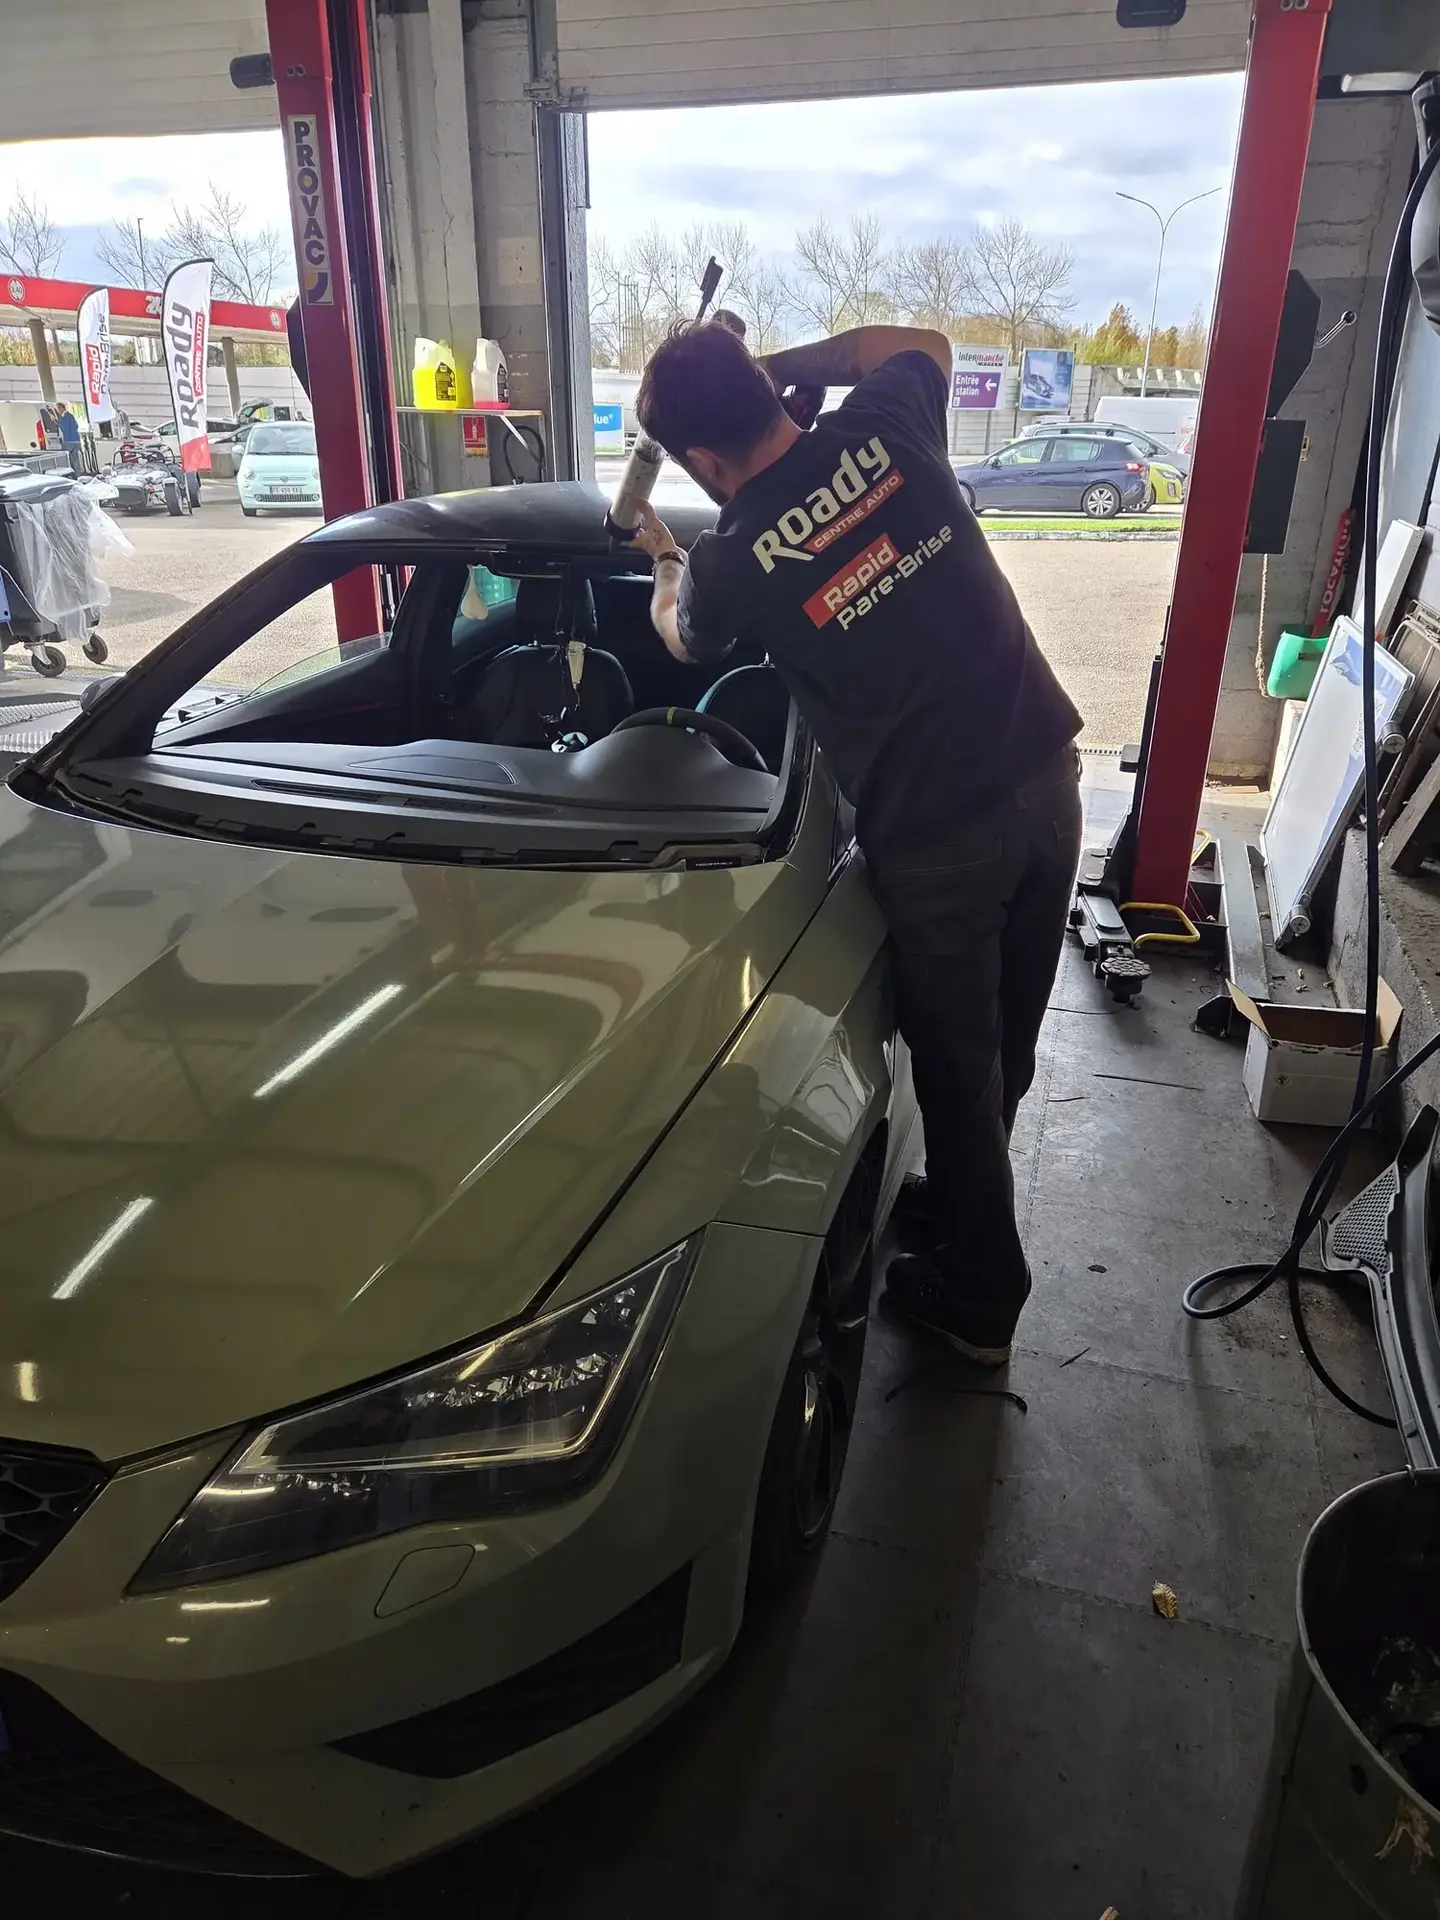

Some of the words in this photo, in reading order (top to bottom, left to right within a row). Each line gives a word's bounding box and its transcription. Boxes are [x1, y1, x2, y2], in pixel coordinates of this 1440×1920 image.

[293, 121, 325, 266] PROVAC
[88, 346, 100, 394] Rapid
[166, 301, 203, 429] Roady
[955, 386, 980, 396] station
[956, 374, 980, 385] Entrée
[752, 436, 891, 574] Roady
[813, 507, 865, 549] CENTRE
[866, 475, 900, 509] AUTO
[822, 541, 895, 612] Rapid
[836, 525, 952, 631] Pare-Brise
